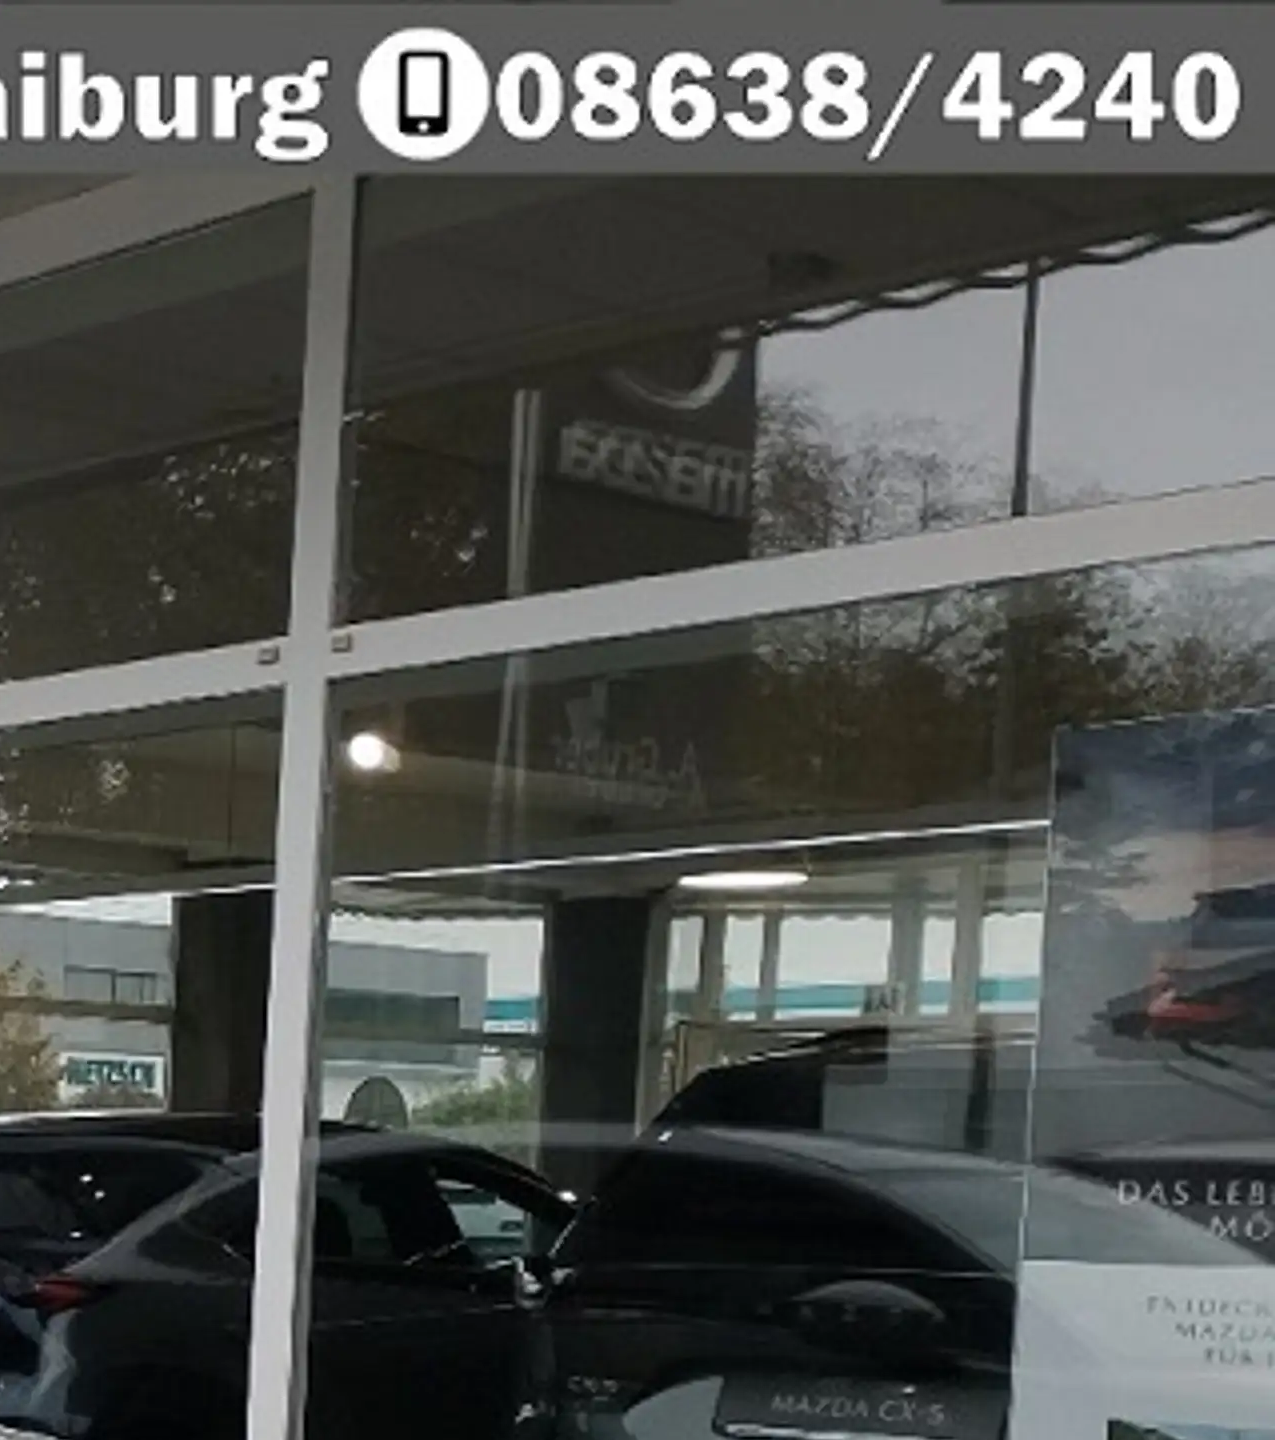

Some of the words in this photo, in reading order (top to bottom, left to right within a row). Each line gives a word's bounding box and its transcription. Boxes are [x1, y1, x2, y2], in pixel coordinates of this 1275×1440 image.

[1117, 1178, 1191, 1206] DAS
[1206, 1178, 1275, 1206] LEB
[770, 1394, 869, 1419] MAZDA
